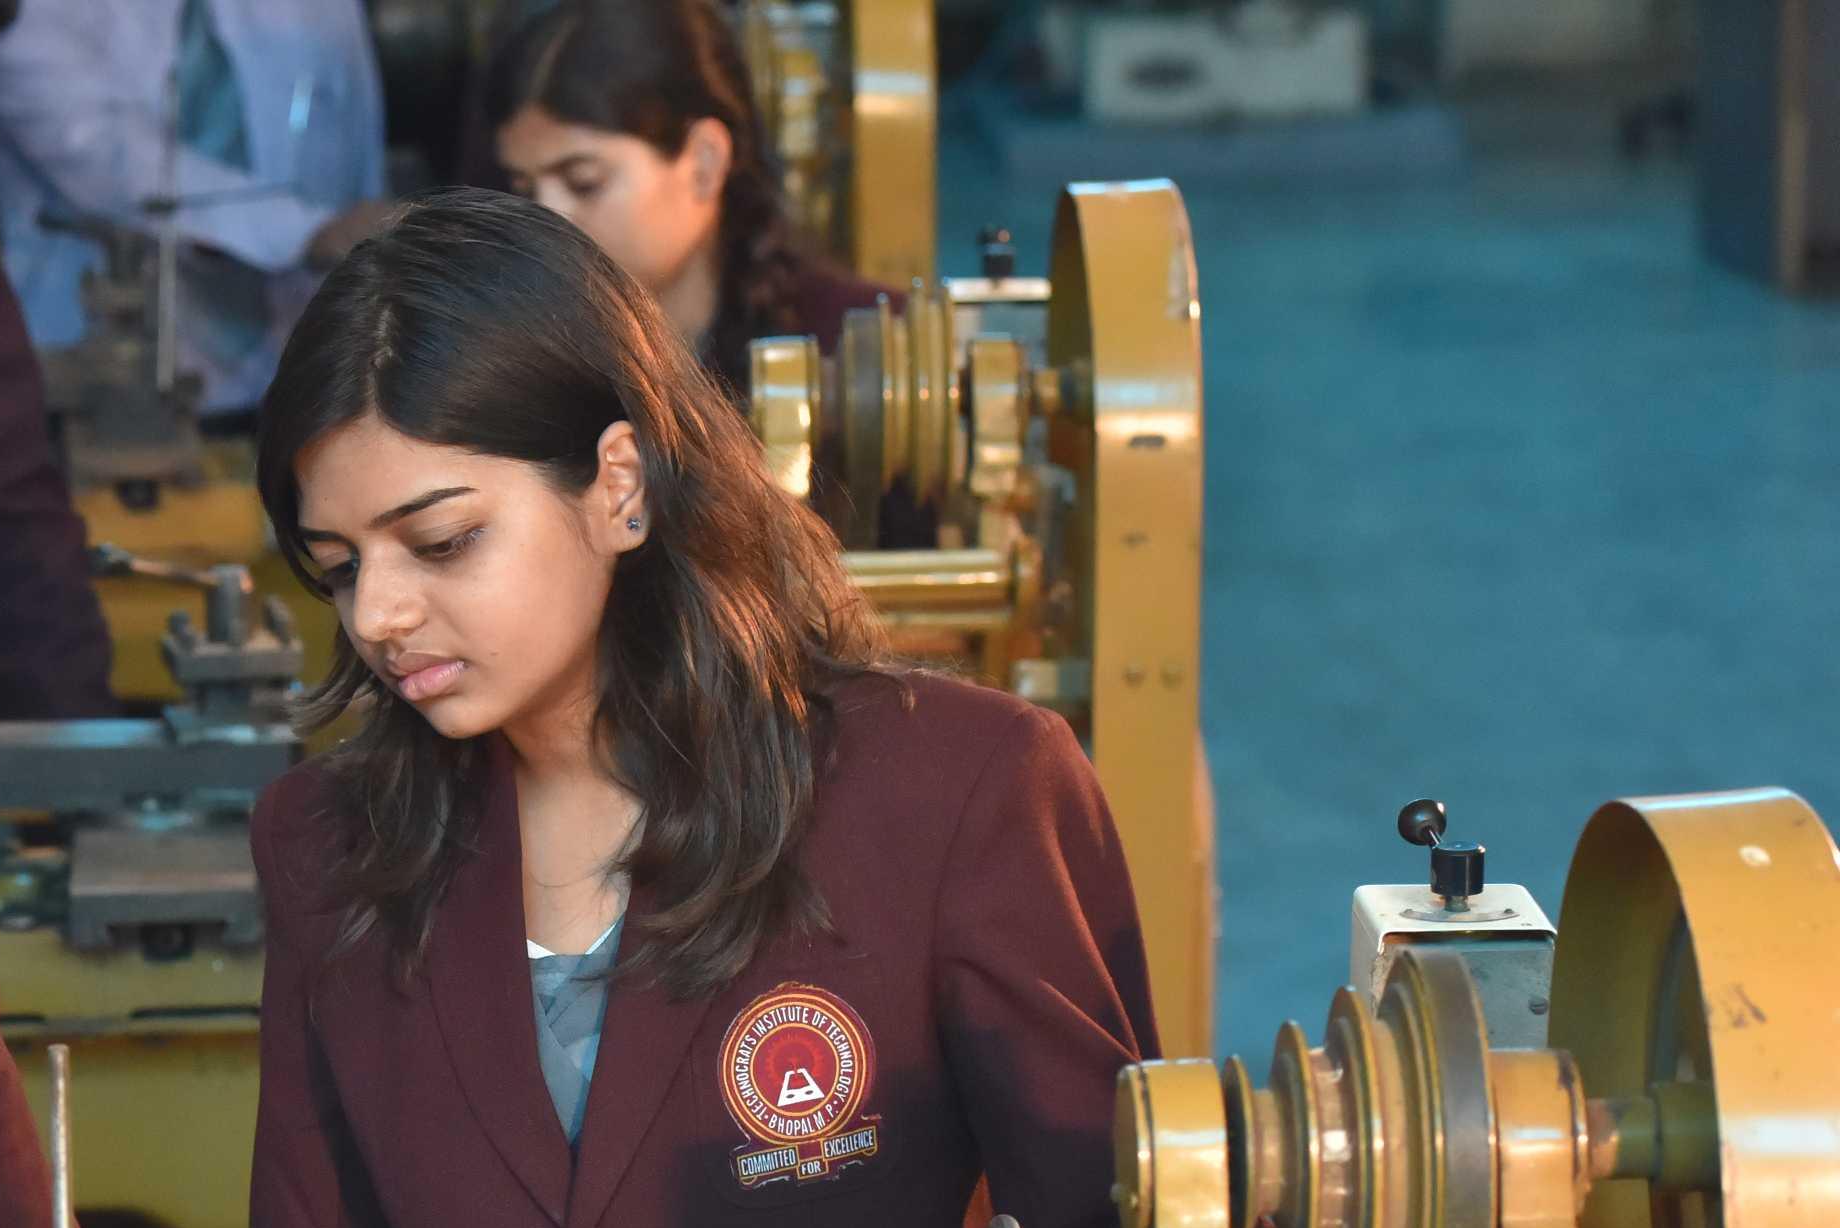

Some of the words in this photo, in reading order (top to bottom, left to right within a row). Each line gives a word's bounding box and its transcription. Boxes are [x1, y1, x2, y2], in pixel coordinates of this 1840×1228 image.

[735, 1034, 766, 1119] TECHNOCRATS
[752, 1006, 809, 1037] INSTITUTE
[811, 1011, 828, 1029] OF
[825, 1022, 853, 1102] TECHNOLOGY
[768, 1116, 815, 1137] BHOPAL
[824, 1129, 874, 1158] EXCELLENCE
[740, 1149, 796, 1176] COMMITTED
[801, 1161, 821, 1175] FOR
